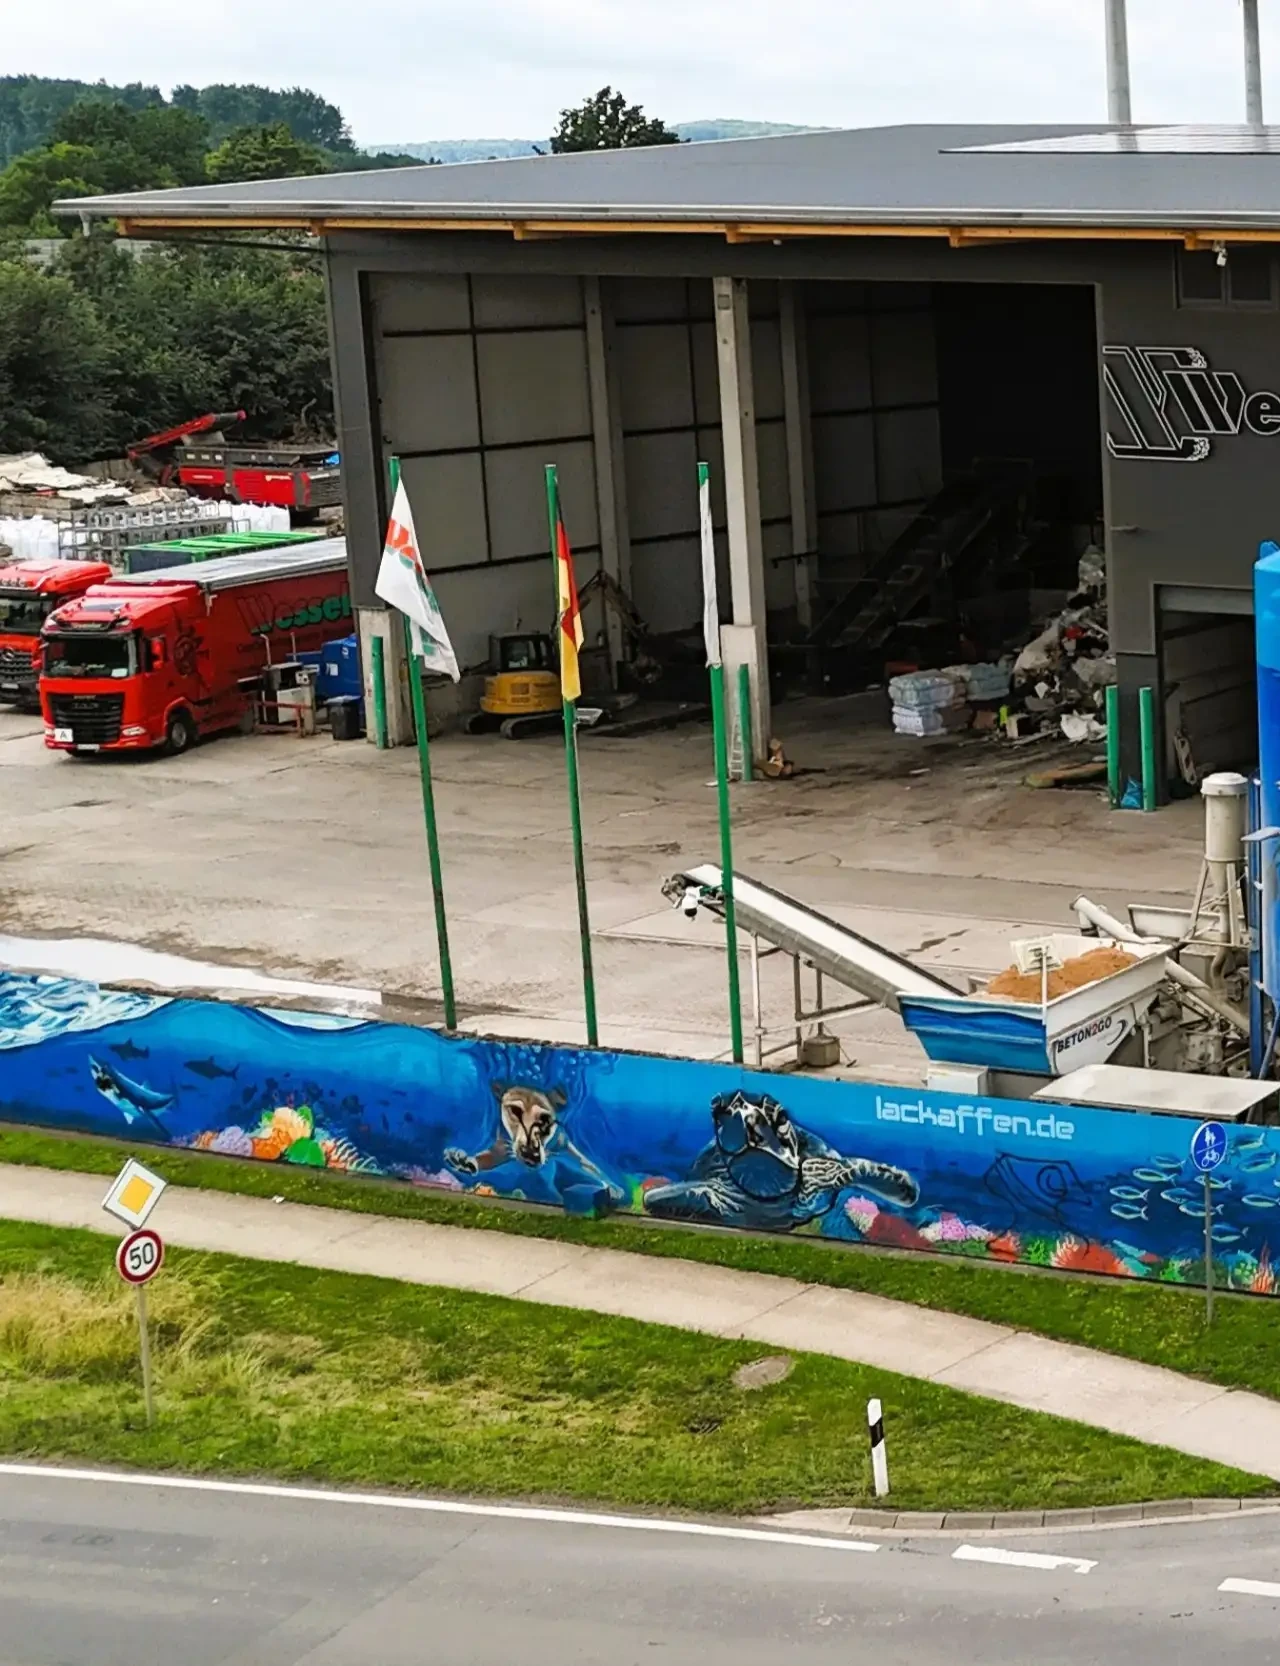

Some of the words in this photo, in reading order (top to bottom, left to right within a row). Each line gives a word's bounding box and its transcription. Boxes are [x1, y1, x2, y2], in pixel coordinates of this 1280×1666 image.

[238, 581, 351, 635] Wessel
[60, 731, 67, 740] A
[1057, 1015, 1112, 1053] BETON2GO
[876, 1096, 1075, 1140] lackaffen.de
[130, 1242, 154, 1270] 50
